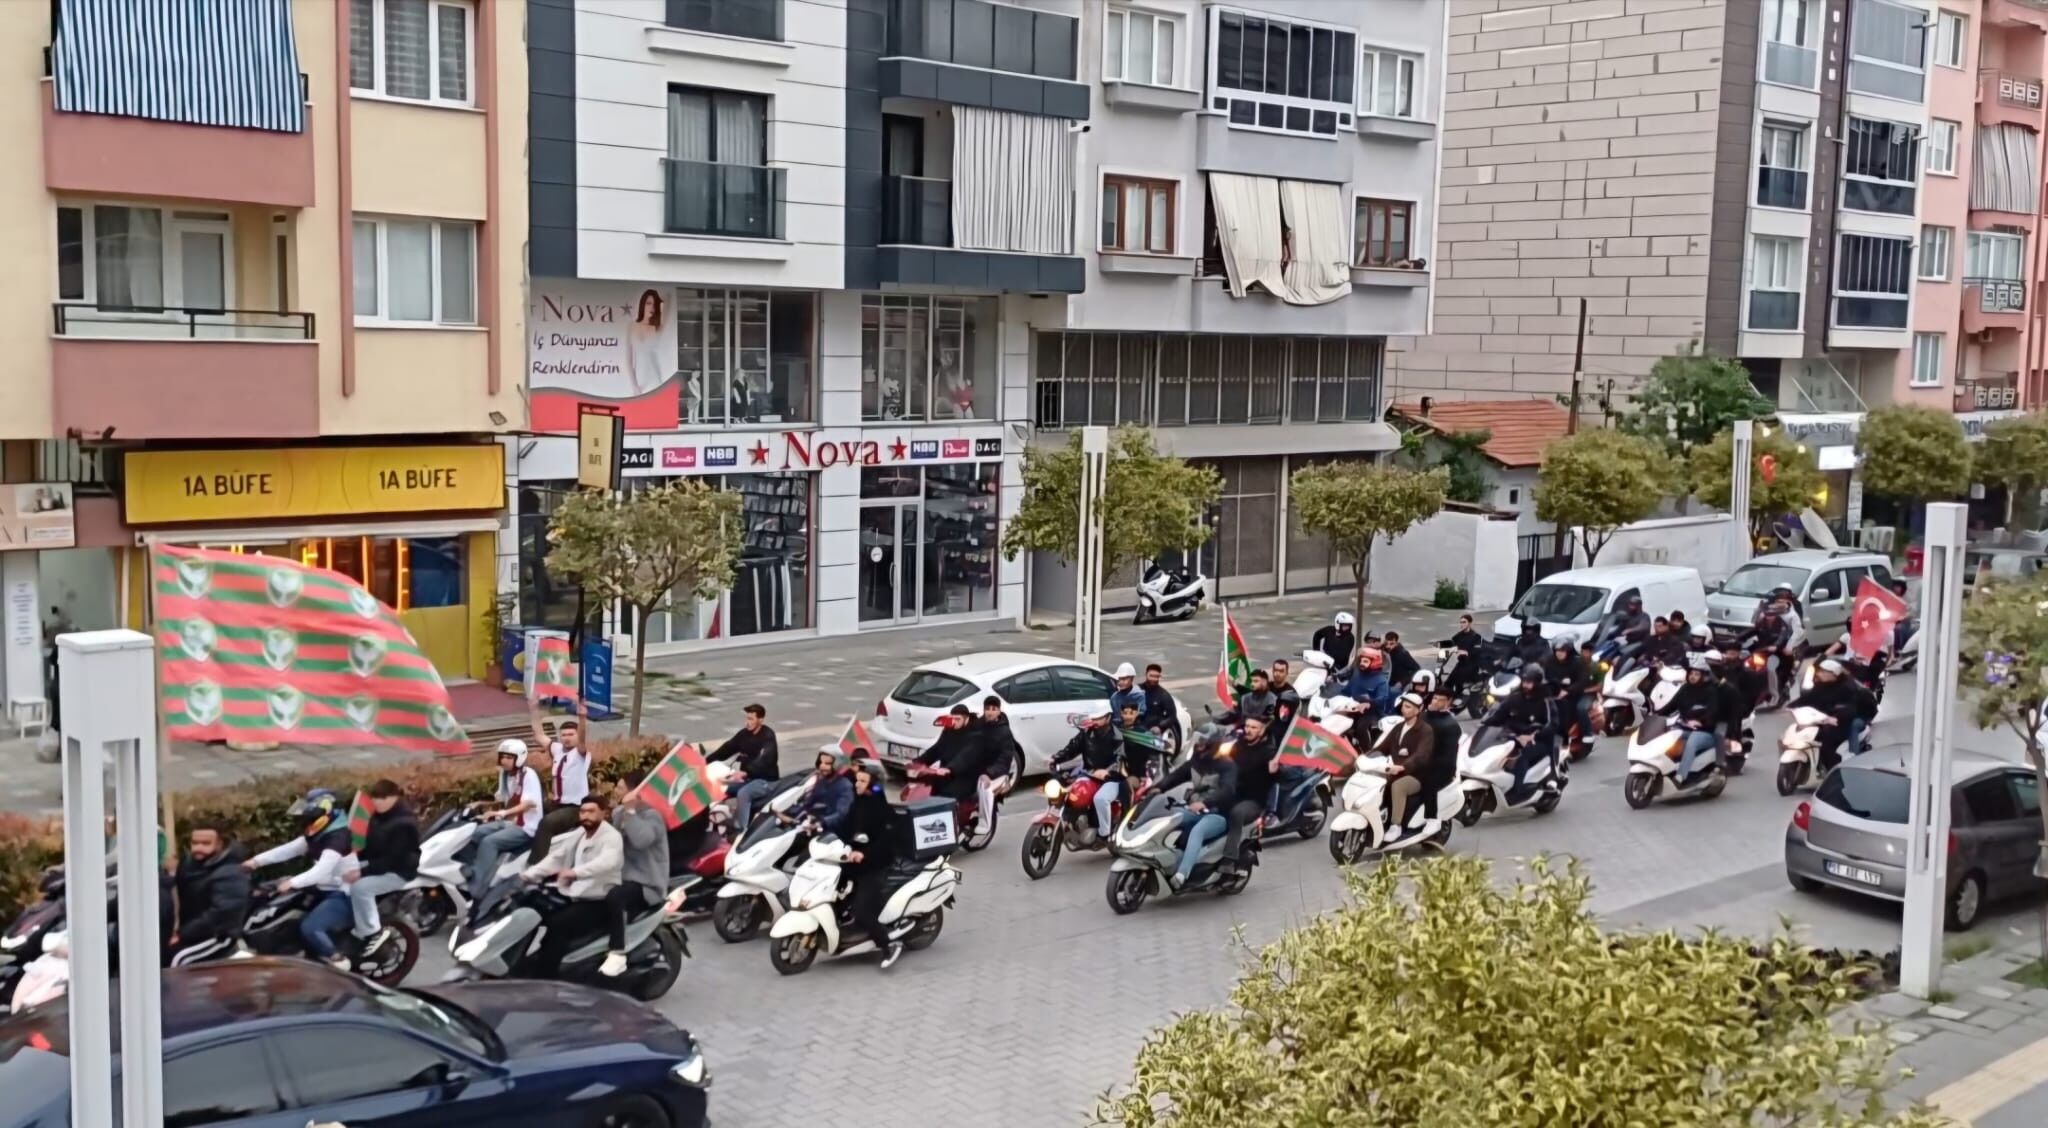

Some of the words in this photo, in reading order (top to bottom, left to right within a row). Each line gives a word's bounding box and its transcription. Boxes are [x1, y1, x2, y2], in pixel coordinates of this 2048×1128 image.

[541, 295, 614, 323] Nova
[532, 359, 620, 374] Renklendirin
[780, 430, 881, 470] Nova
[184, 476, 207, 497] 1A
[214, 470, 272, 496] BÜFE
[379, 470, 400, 490] 1A
[406, 464, 457, 489] BÜFE
